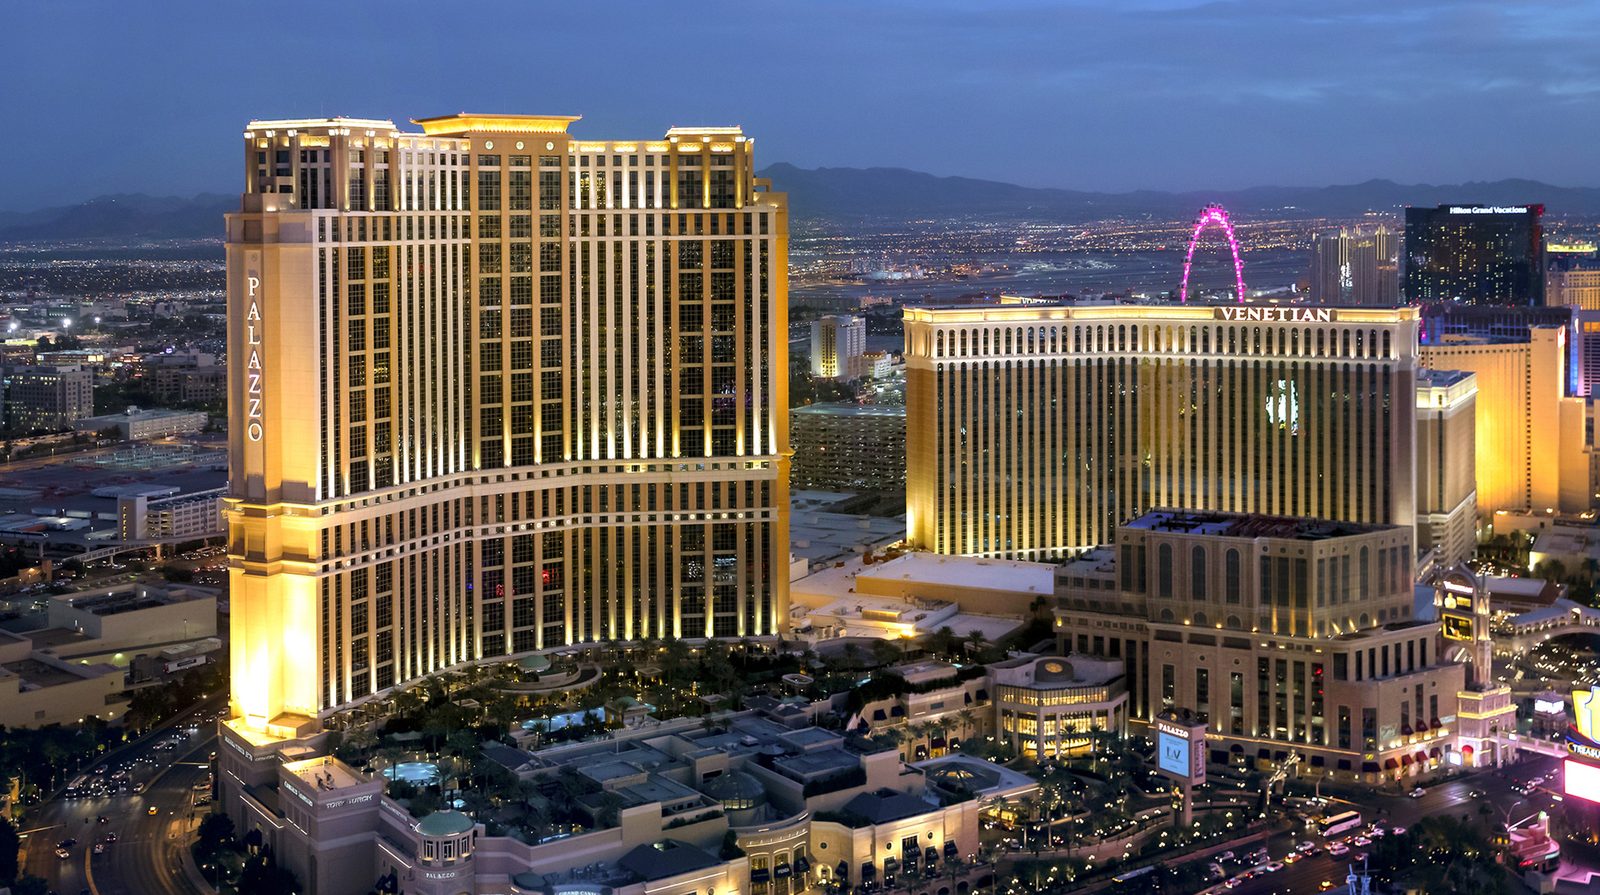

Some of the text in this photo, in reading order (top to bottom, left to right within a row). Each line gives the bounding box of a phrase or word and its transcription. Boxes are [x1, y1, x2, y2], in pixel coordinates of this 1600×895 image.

[1471, 206, 1494, 214] Grand
[1494, 206, 1527, 214] Vacations
[1220, 306, 1331, 322] VENETIAN
[247, 276, 263, 442] PALAZZO
[1159, 723, 1188, 738] PALAZZO
